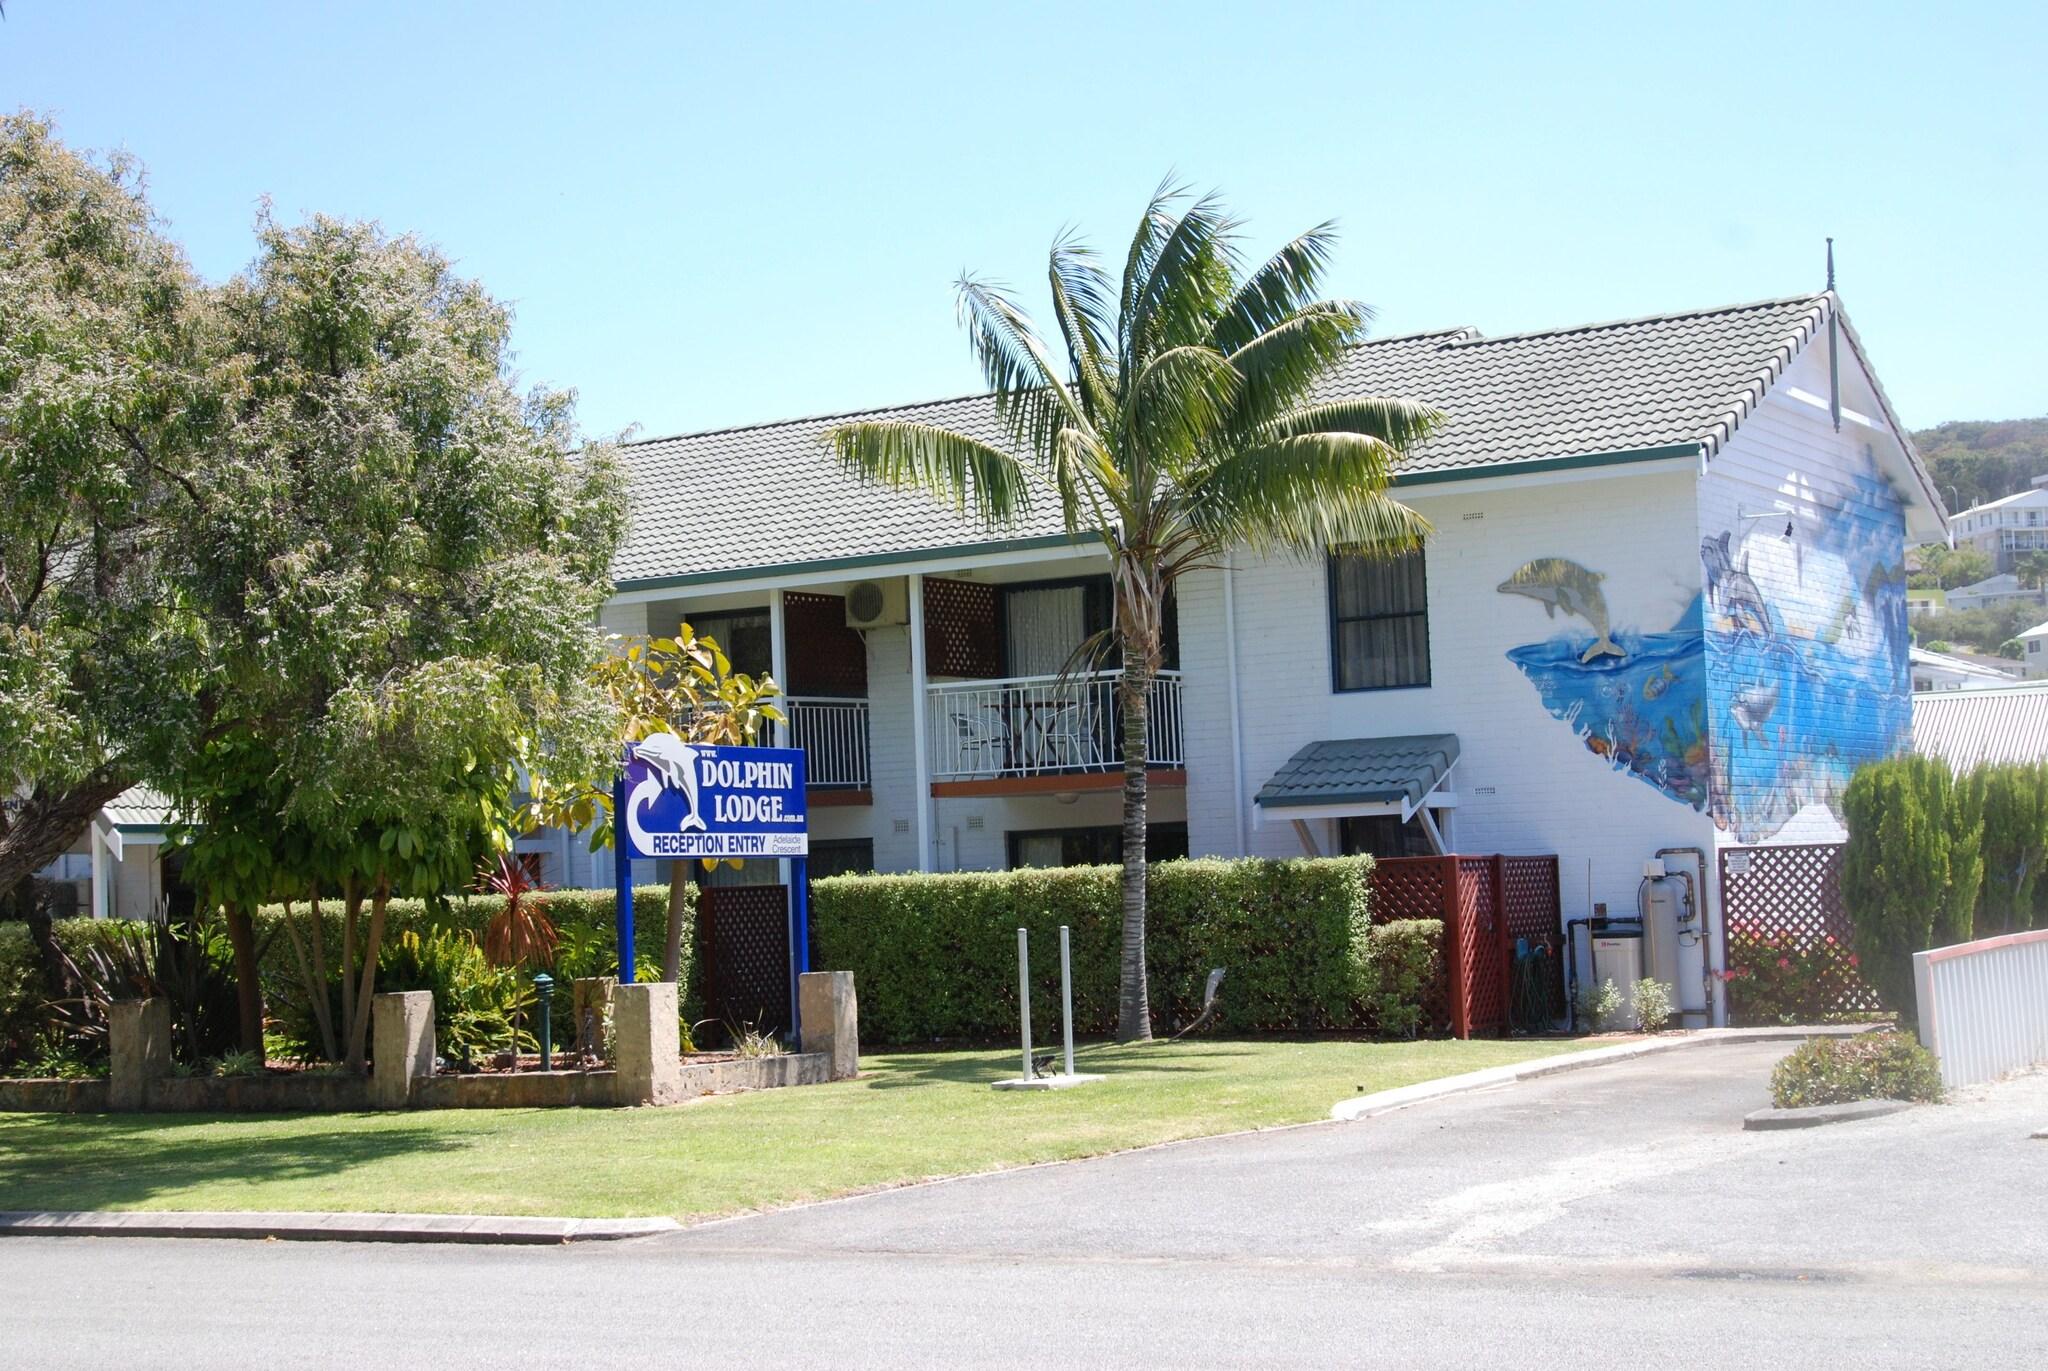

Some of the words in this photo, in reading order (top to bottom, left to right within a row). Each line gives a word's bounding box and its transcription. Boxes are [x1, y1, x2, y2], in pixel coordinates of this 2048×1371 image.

[701, 759, 793, 790] DOLPHIN
[714, 795, 783, 823] LODGE
[653, 834, 724, 854] RECEPTION
[728, 835, 766, 854] ENTRY
[772, 844, 801, 854] Crescent
[773, 834, 801, 844] Adelaide
